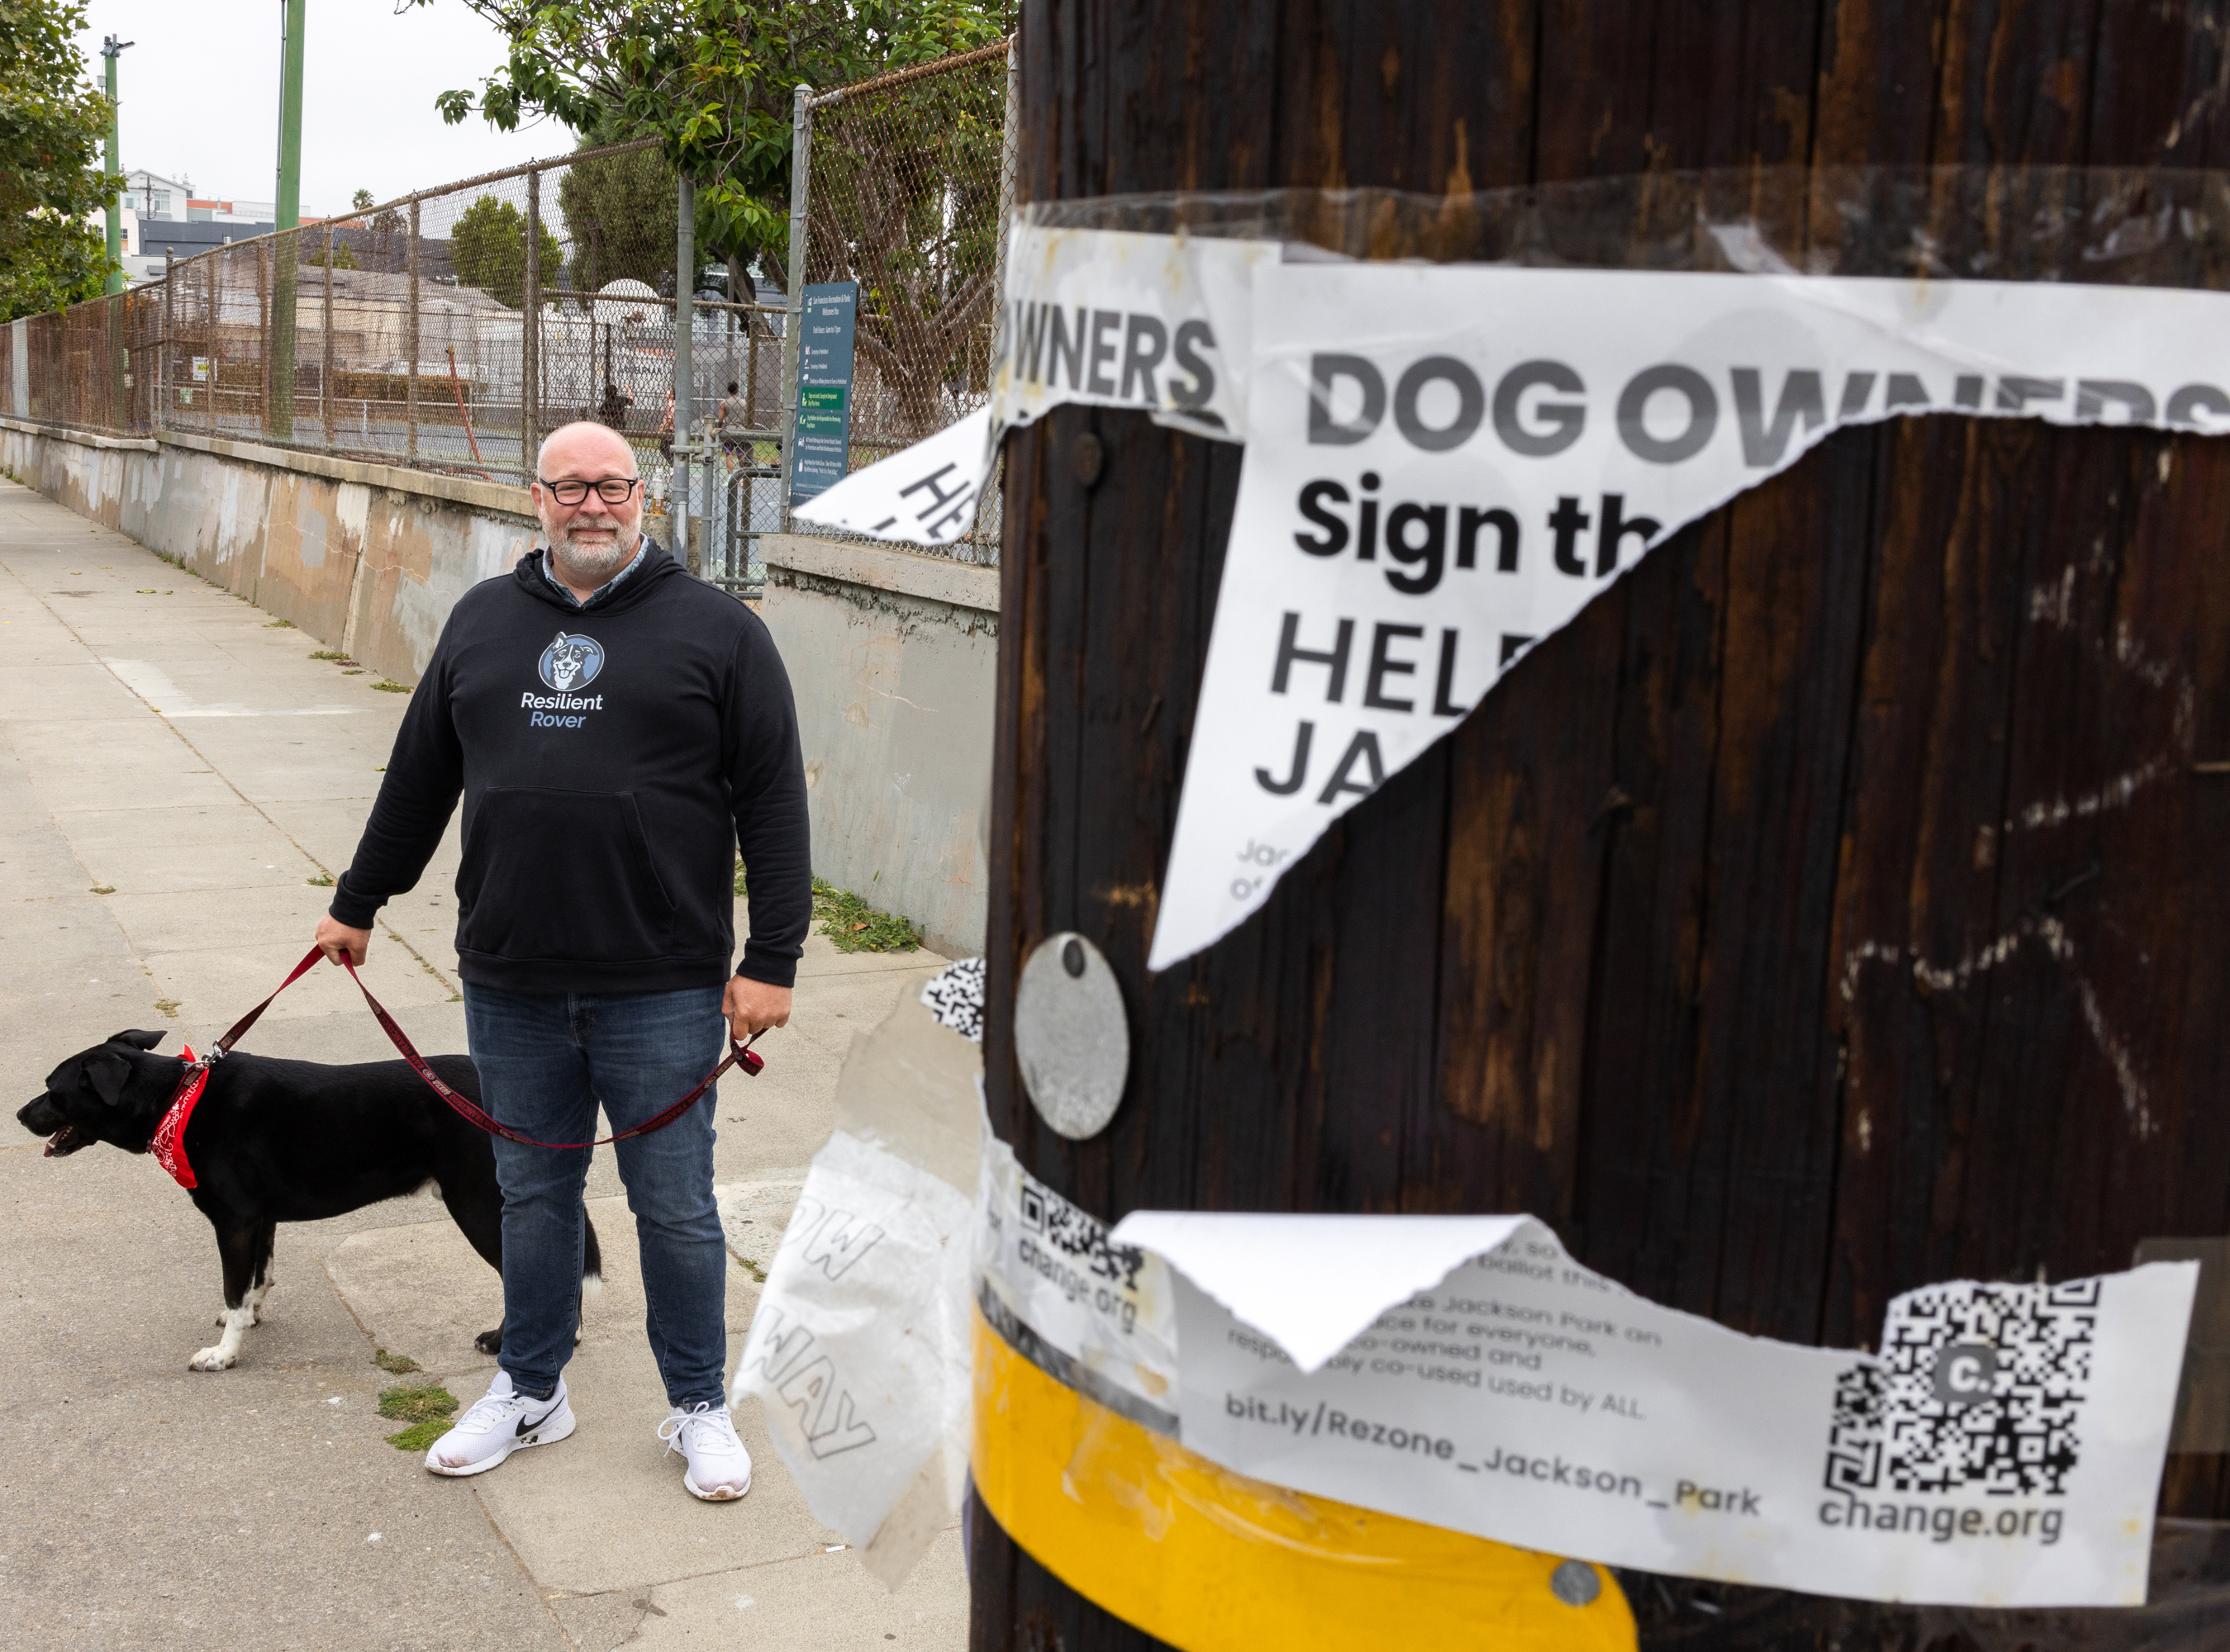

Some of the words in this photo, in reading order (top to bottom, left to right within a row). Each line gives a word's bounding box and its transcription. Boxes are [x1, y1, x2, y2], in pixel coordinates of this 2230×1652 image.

[818, 296, 828, 304] Francisco
[829, 295, 841, 303] Recreation
[1306, 350, 1588, 459] DOG
[1293, 469, 1521, 596] Sign
[1548, 491, 1664, 580] th
[1268, 610, 1538, 719] HEL
[521, 691, 603, 710] Resilient
[530, 710, 587, 729] Rover
[1253, 719, 1389, 807] JA
[379, 1014, 413, 1055] FRANCISCO
[449, 1094, 485, 1123] FRANCISCO
[640, 1103, 688, 1133] FRANCISCO
[1422, 1316, 1460, 1335] for
[1442, 1295, 1554, 1327] Jackson
[1559, 1310, 1618, 1339] Park
[1487, 1347, 1542, 1372] and
[1487, 1374, 1553, 1403] used
[1559, 1384, 1595, 1414] by
[1819, 1487, 2064, 1545] change.org
